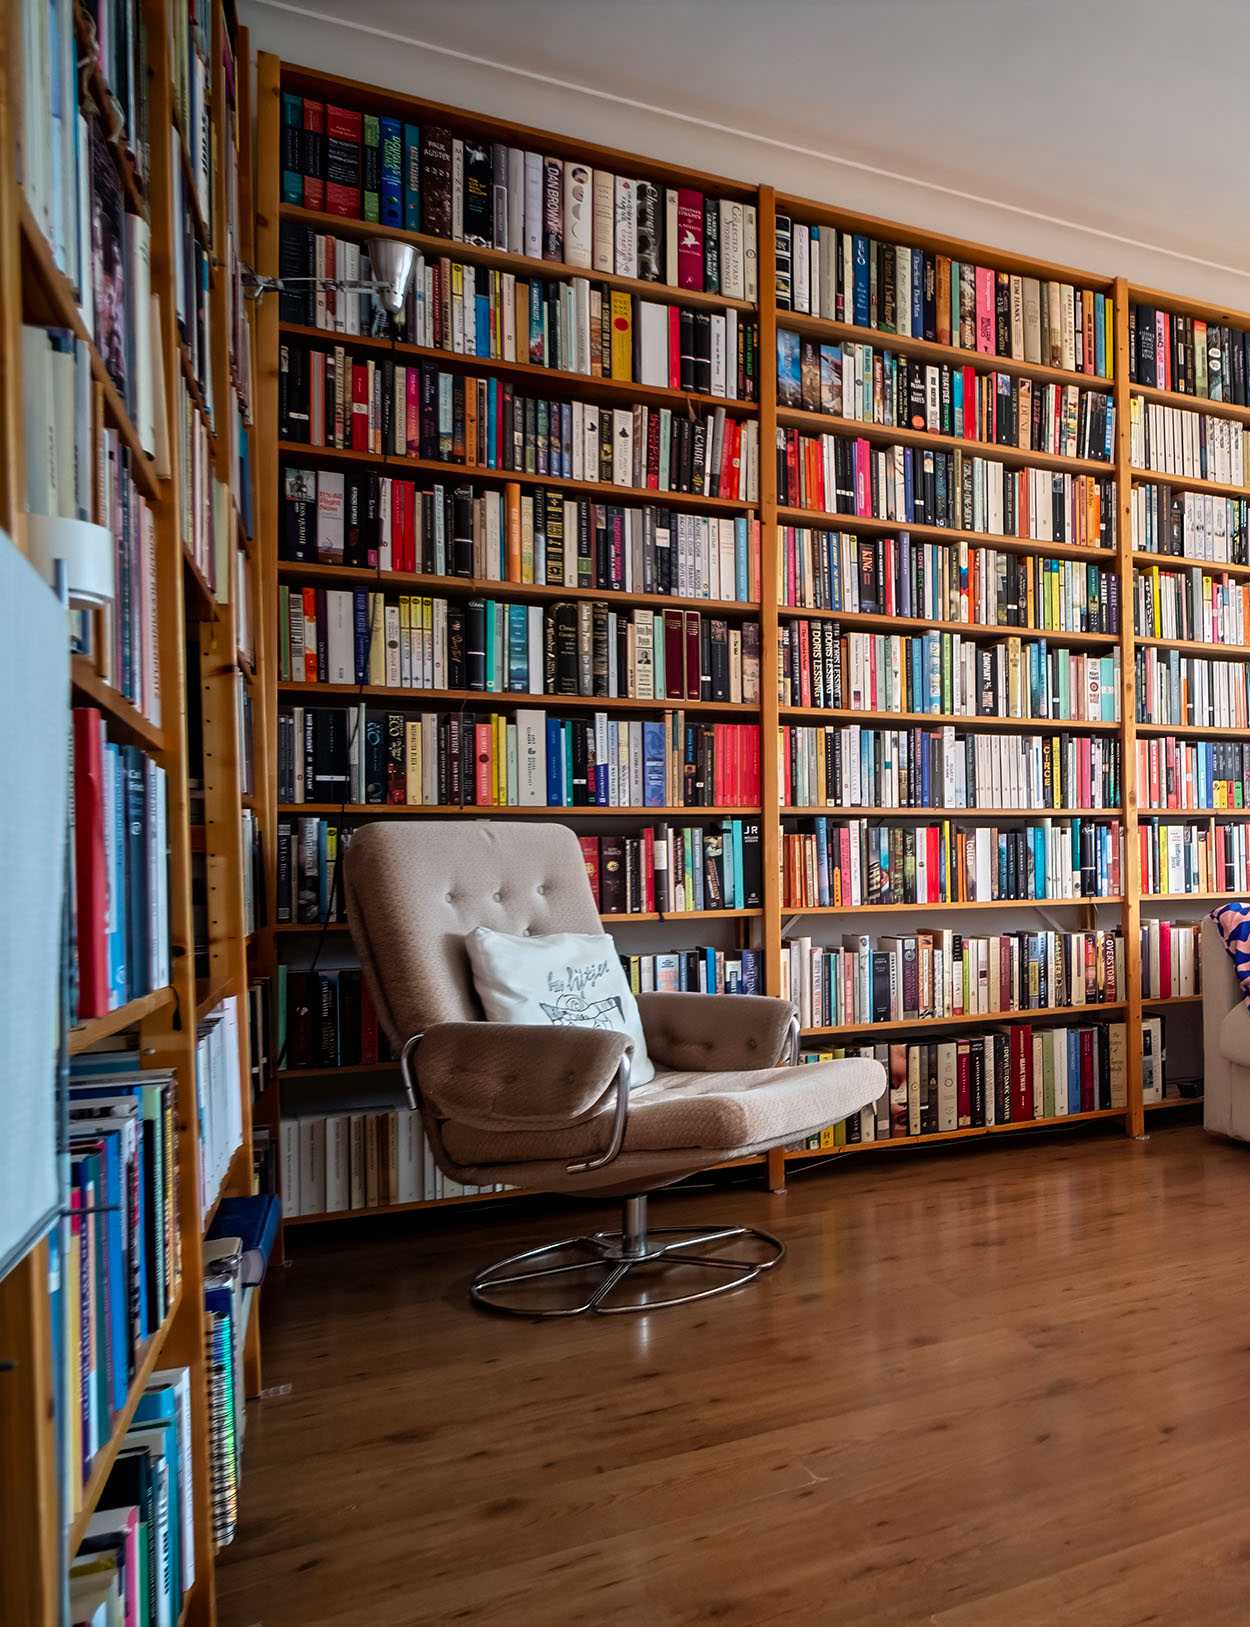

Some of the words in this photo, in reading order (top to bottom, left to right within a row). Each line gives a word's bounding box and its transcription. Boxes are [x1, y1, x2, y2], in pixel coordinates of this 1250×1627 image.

[392, 136, 401, 175] DOUGLAS
[424, 150, 450, 162] AUSTER
[427, 141, 446, 152] PAUL
[547, 168, 560, 189] DAN
[547, 189, 561, 227] BROWN
[647, 186, 659, 236] Cheever
[1013, 279, 1021, 294] TOM
[1013, 295, 1022, 322] HANKS
[694, 435, 704, 466] CARRÉ
[862, 550, 873, 572] KING
[812, 631, 821, 657] DORIS
[825, 631, 833, 657] DORIS
[812, 659, 821, 697] LESSING
[825, 658, 833, 694] LESSING
[982, 652, 991, 682] COMPANY
[388, 715, 402, 737] ECO
[743, 826, 758, 835] JR
[966, 840, 975, 865] lolita
[746, 953, 757, 994] HAMILTON
[1105, 940, 1115, 986] OVERSTORY
